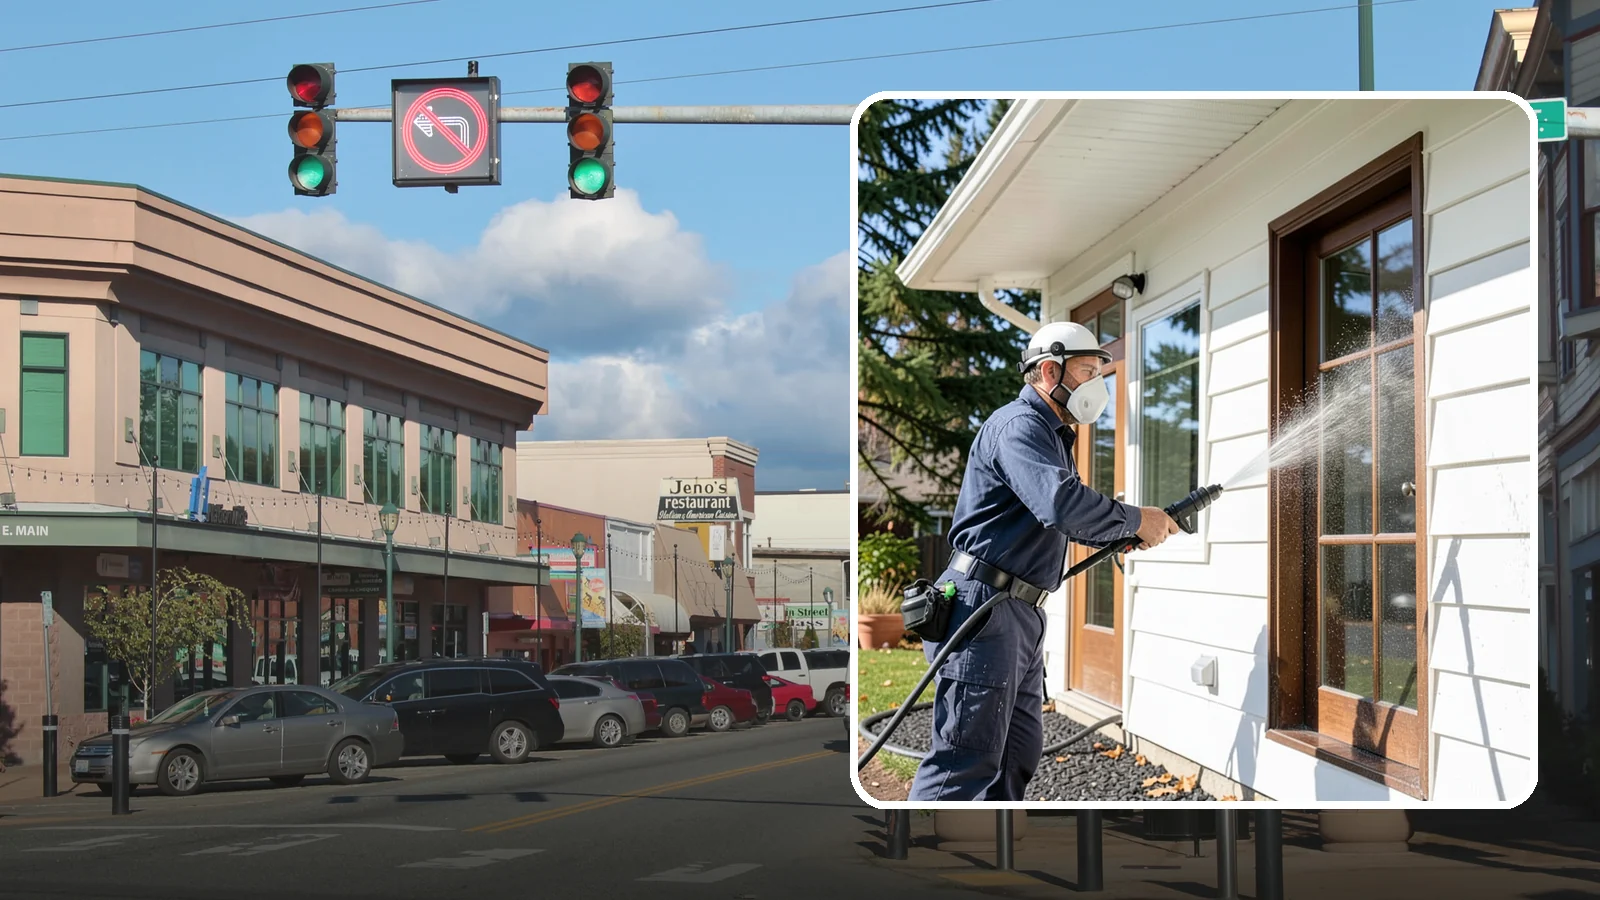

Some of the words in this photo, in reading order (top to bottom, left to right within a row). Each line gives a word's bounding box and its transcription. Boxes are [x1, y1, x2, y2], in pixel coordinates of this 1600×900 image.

[669, 480, 727, 495] Jeno's
[665, 496, 731, 509] restaurant
[658, 509, 682, 519] Italian
[686, 509, 714, 519] American
[715, 509, 737, 519] Cuisine
[2, 525, 13, 536] E.
[15, 525, 49, 536] MAIN
[797, 607, 828, 617] Street
